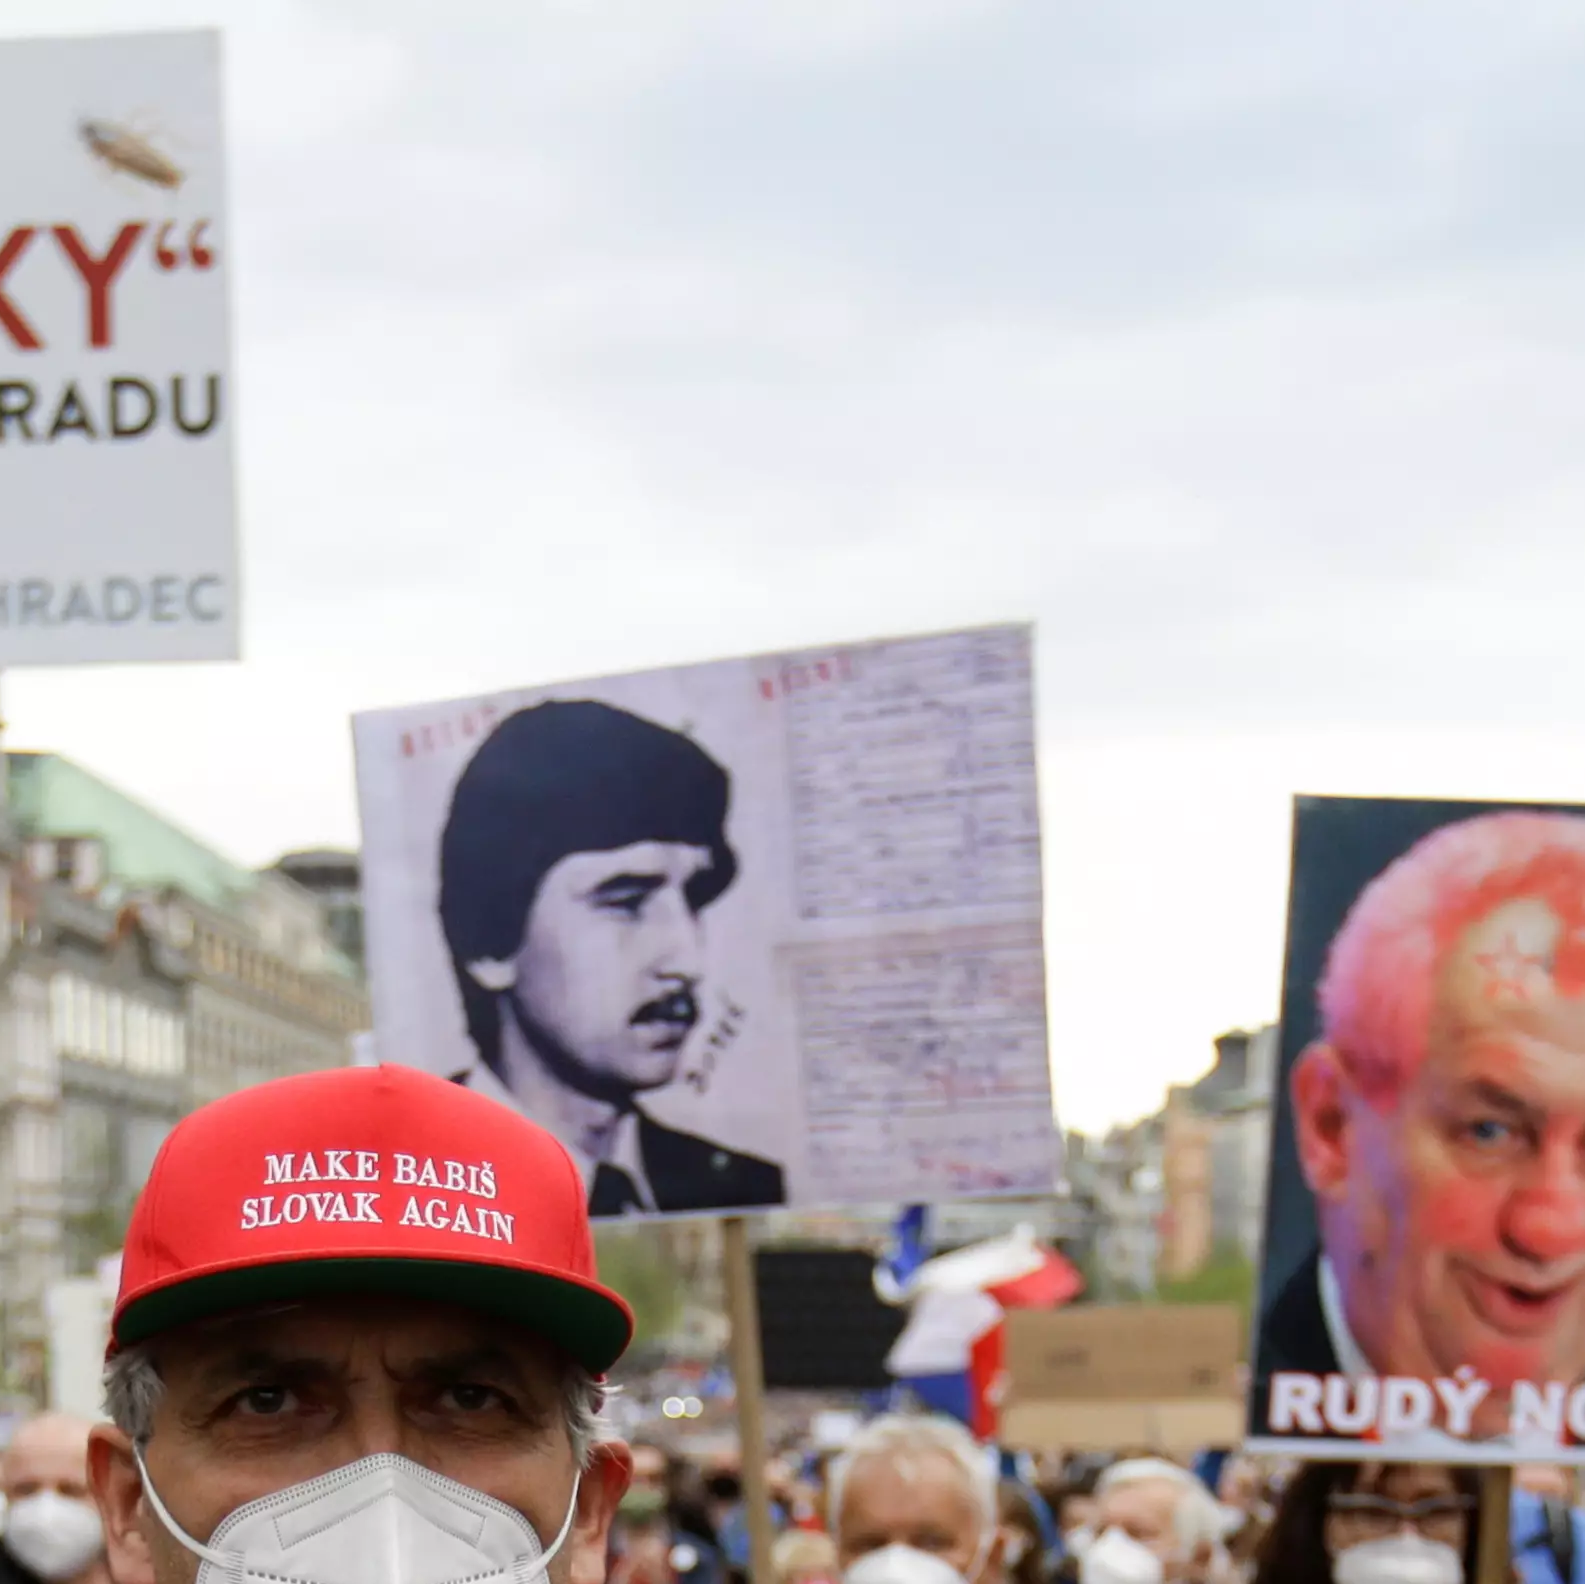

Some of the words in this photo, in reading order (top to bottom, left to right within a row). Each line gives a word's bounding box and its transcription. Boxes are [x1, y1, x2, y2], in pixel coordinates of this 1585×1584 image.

[264, 1150, 380, 1185] MAKE
[393, 1153, 497, 1199] BABIŠ
[241, 1192, 383, 1230] SLOVAK
[398, 1195, 515, 1244] AGAIN
[1268, 1364, 1492, 1436] RUDÝ
